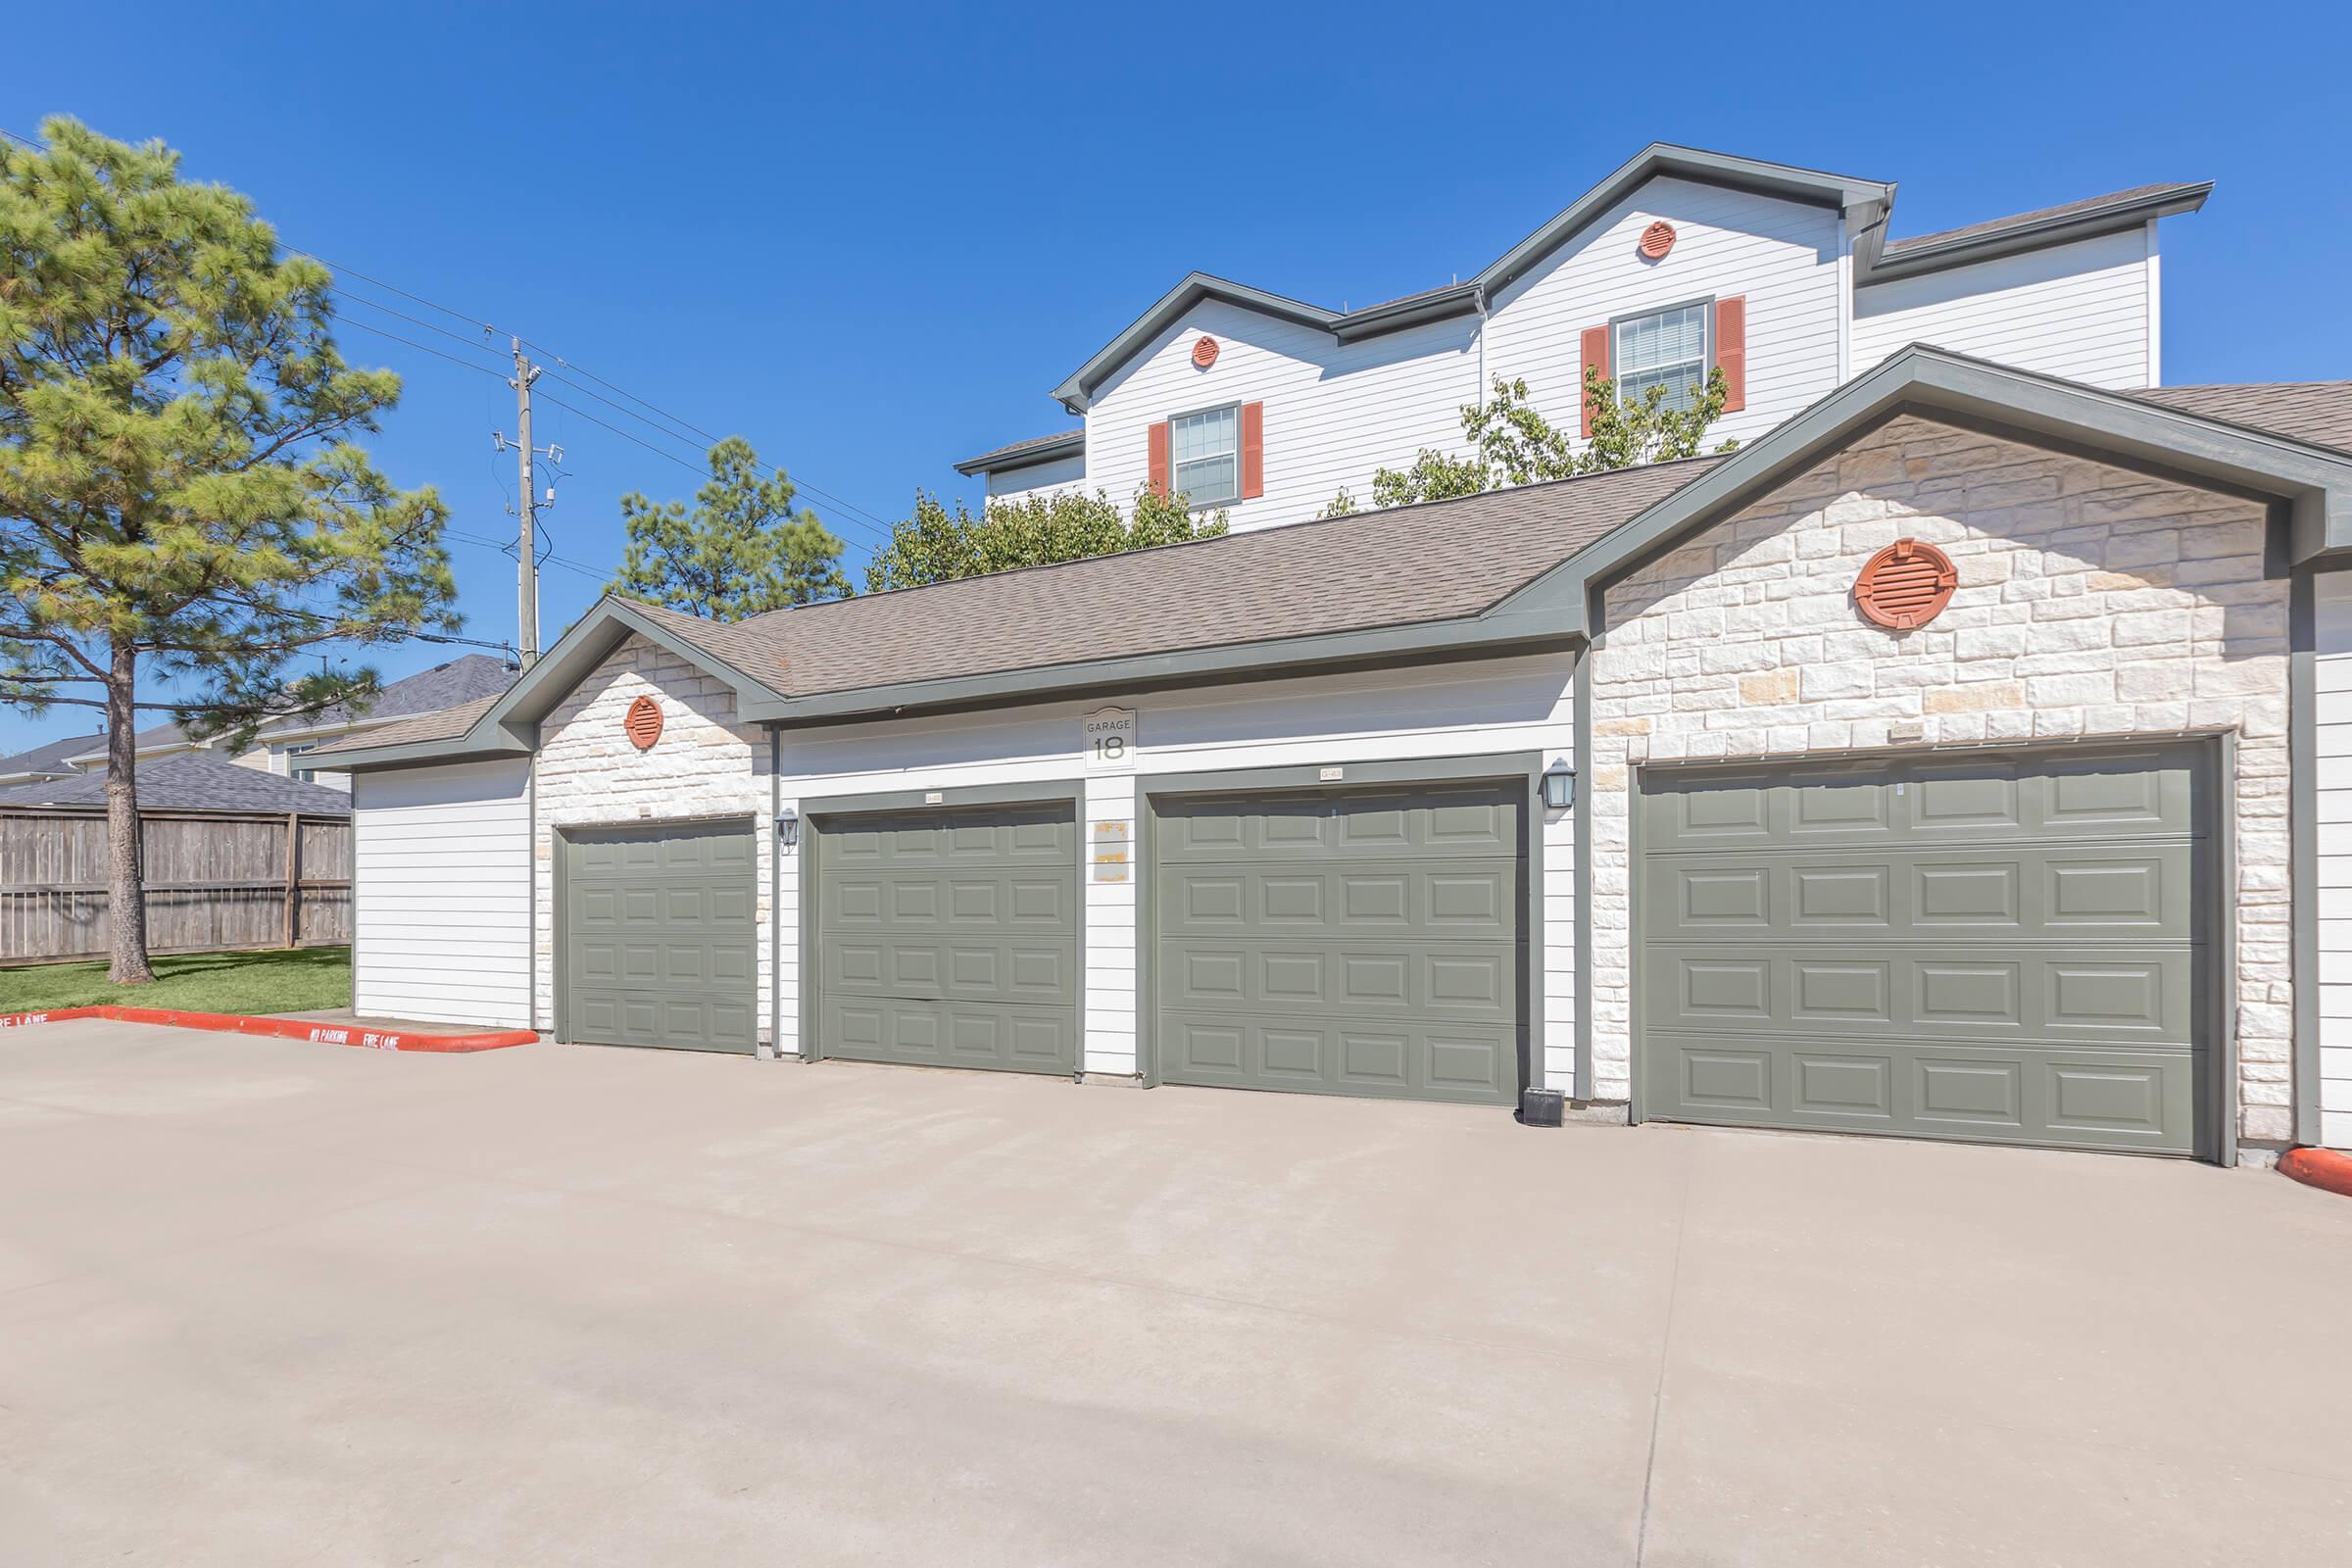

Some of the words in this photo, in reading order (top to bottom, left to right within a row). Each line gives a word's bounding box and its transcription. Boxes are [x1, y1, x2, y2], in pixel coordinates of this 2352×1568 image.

[1087, 720, 1131, 733] GARAGE
[1095, 736, 1125, 760] 18
[16, 1014, 48, 1027] LANE
[310, 1028, 320, 1043] NO
[320, 1029, 349, 1044] PARKING
[363, 1033, 380, 1048] FIRE
[379, 1035, 401, 1051] LANE
